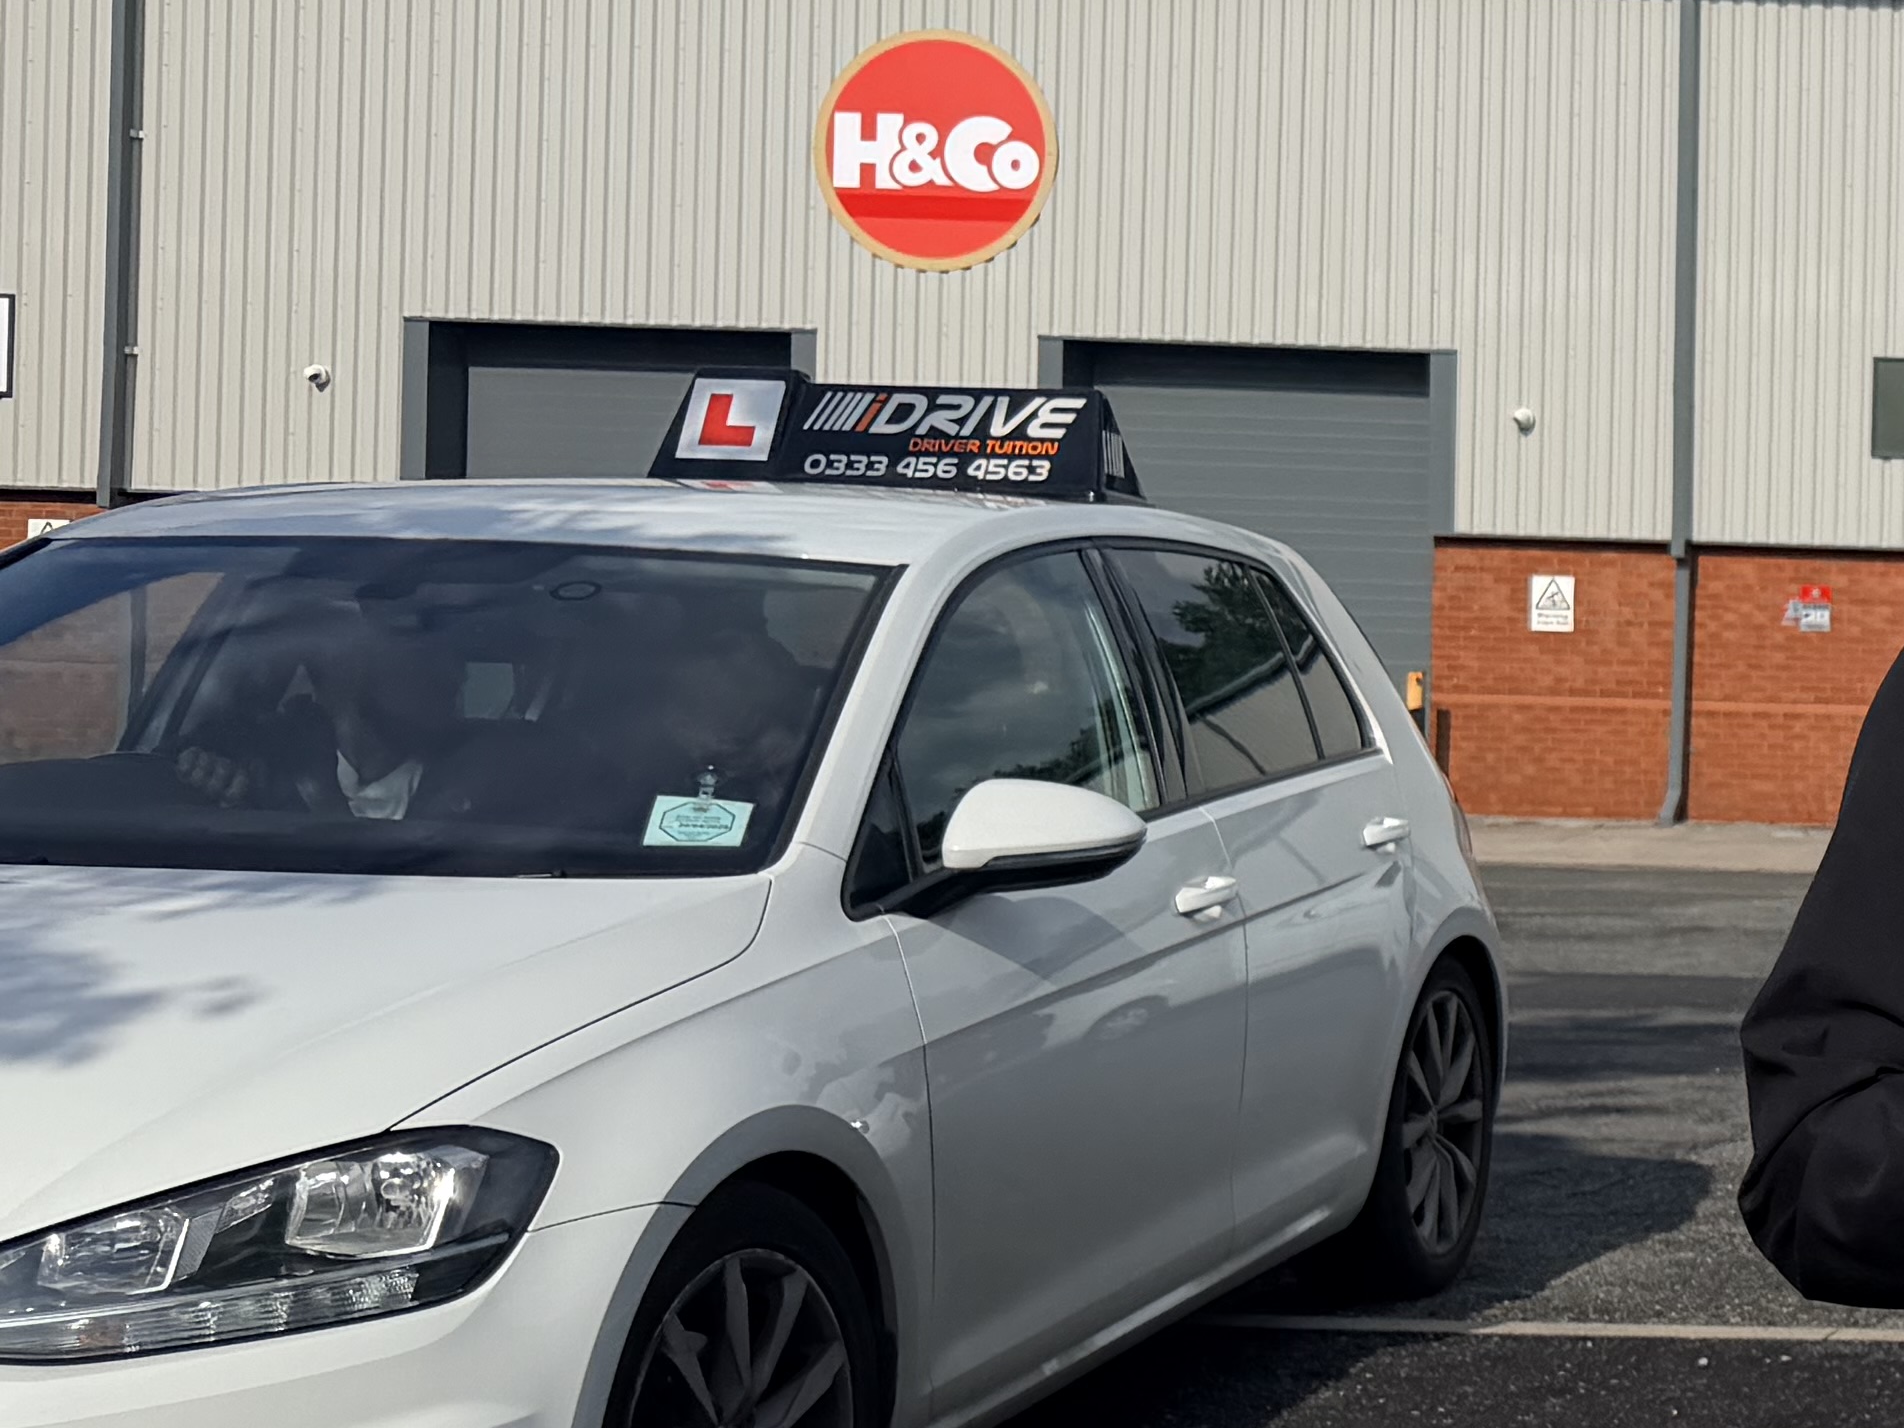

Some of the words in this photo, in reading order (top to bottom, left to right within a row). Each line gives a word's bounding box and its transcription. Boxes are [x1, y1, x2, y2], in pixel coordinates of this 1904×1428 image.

[833, 111, 1040, 193] H&Co
[698, 392, 756, 446] L
[908, 438, 980, 454] DRIVER
[986, 439, 1059, 455] TUITION
[803, 453, 889, 477] 0333
[896, 456, 959, 479] 456
[966, 458, 1052, 482] 4563
